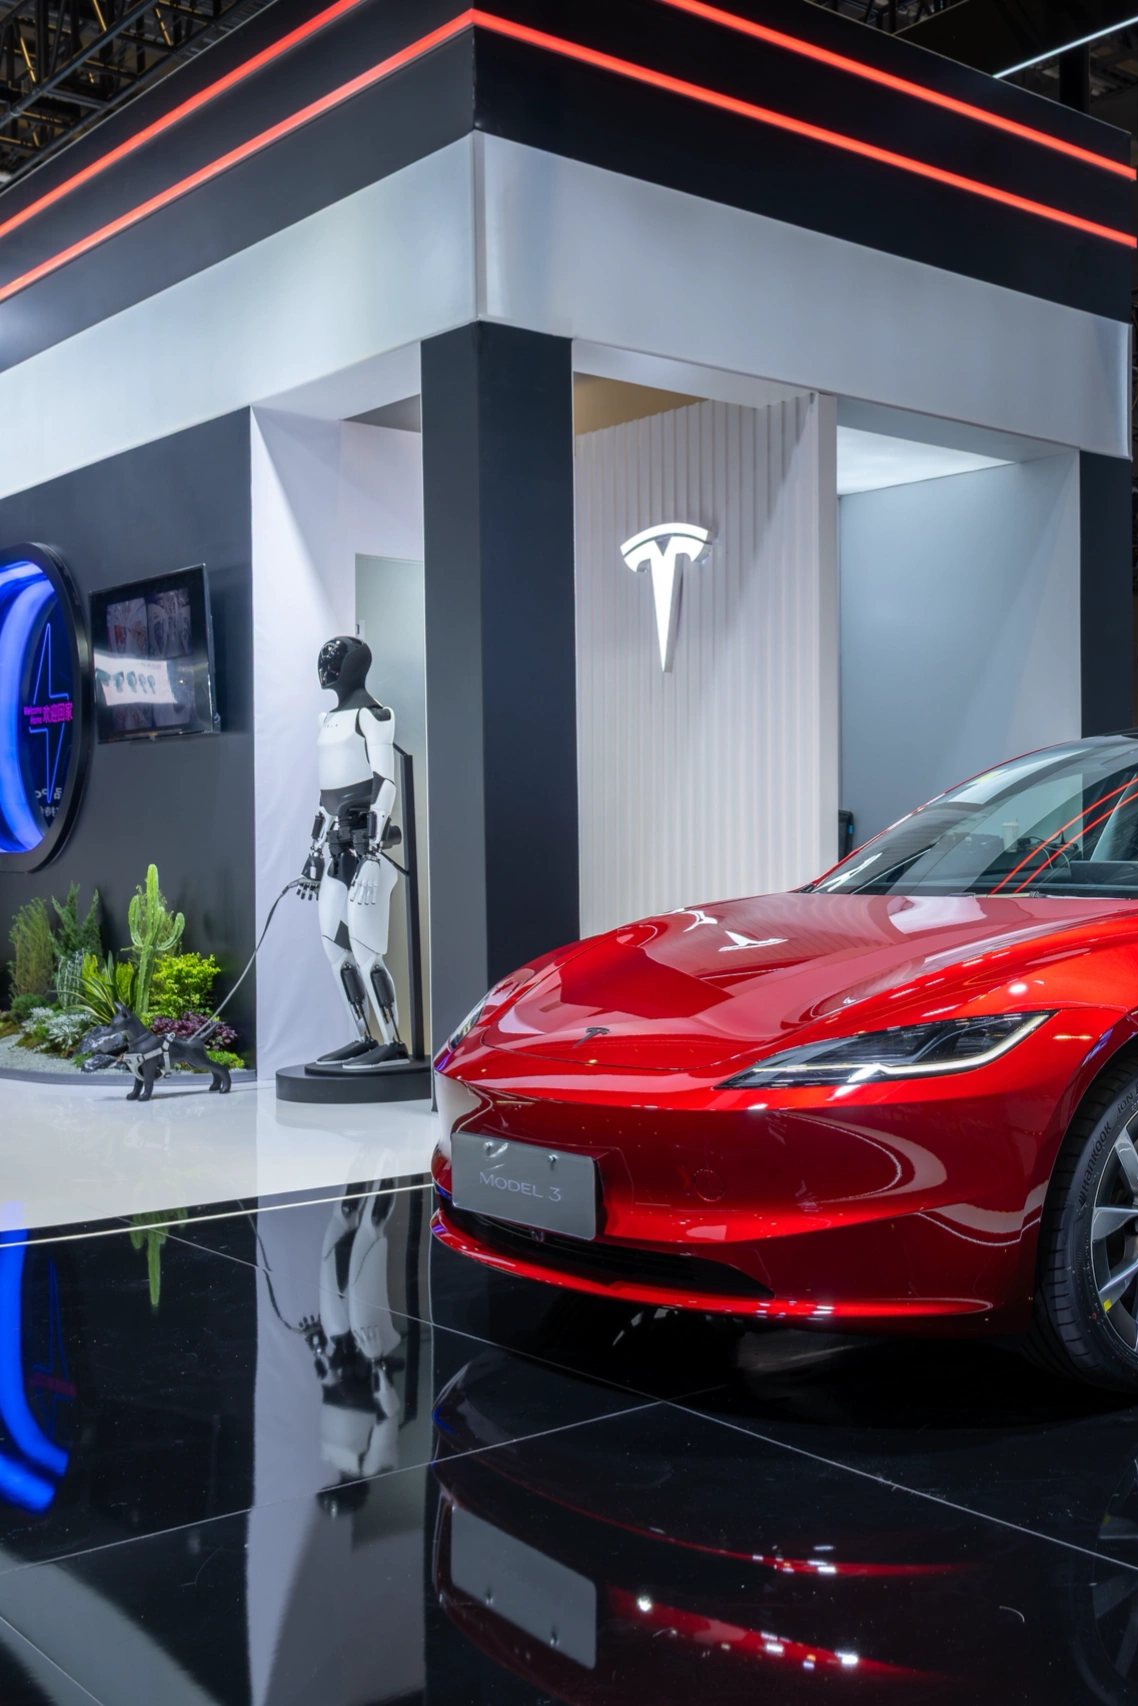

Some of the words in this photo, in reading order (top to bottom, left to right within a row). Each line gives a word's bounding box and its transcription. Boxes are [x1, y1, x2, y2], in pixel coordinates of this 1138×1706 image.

[43, 701, 73, 723] 欢迎回家
[479, 1171, 543, 1198] MODEL
[548, 1186, 562, 1202] 3
